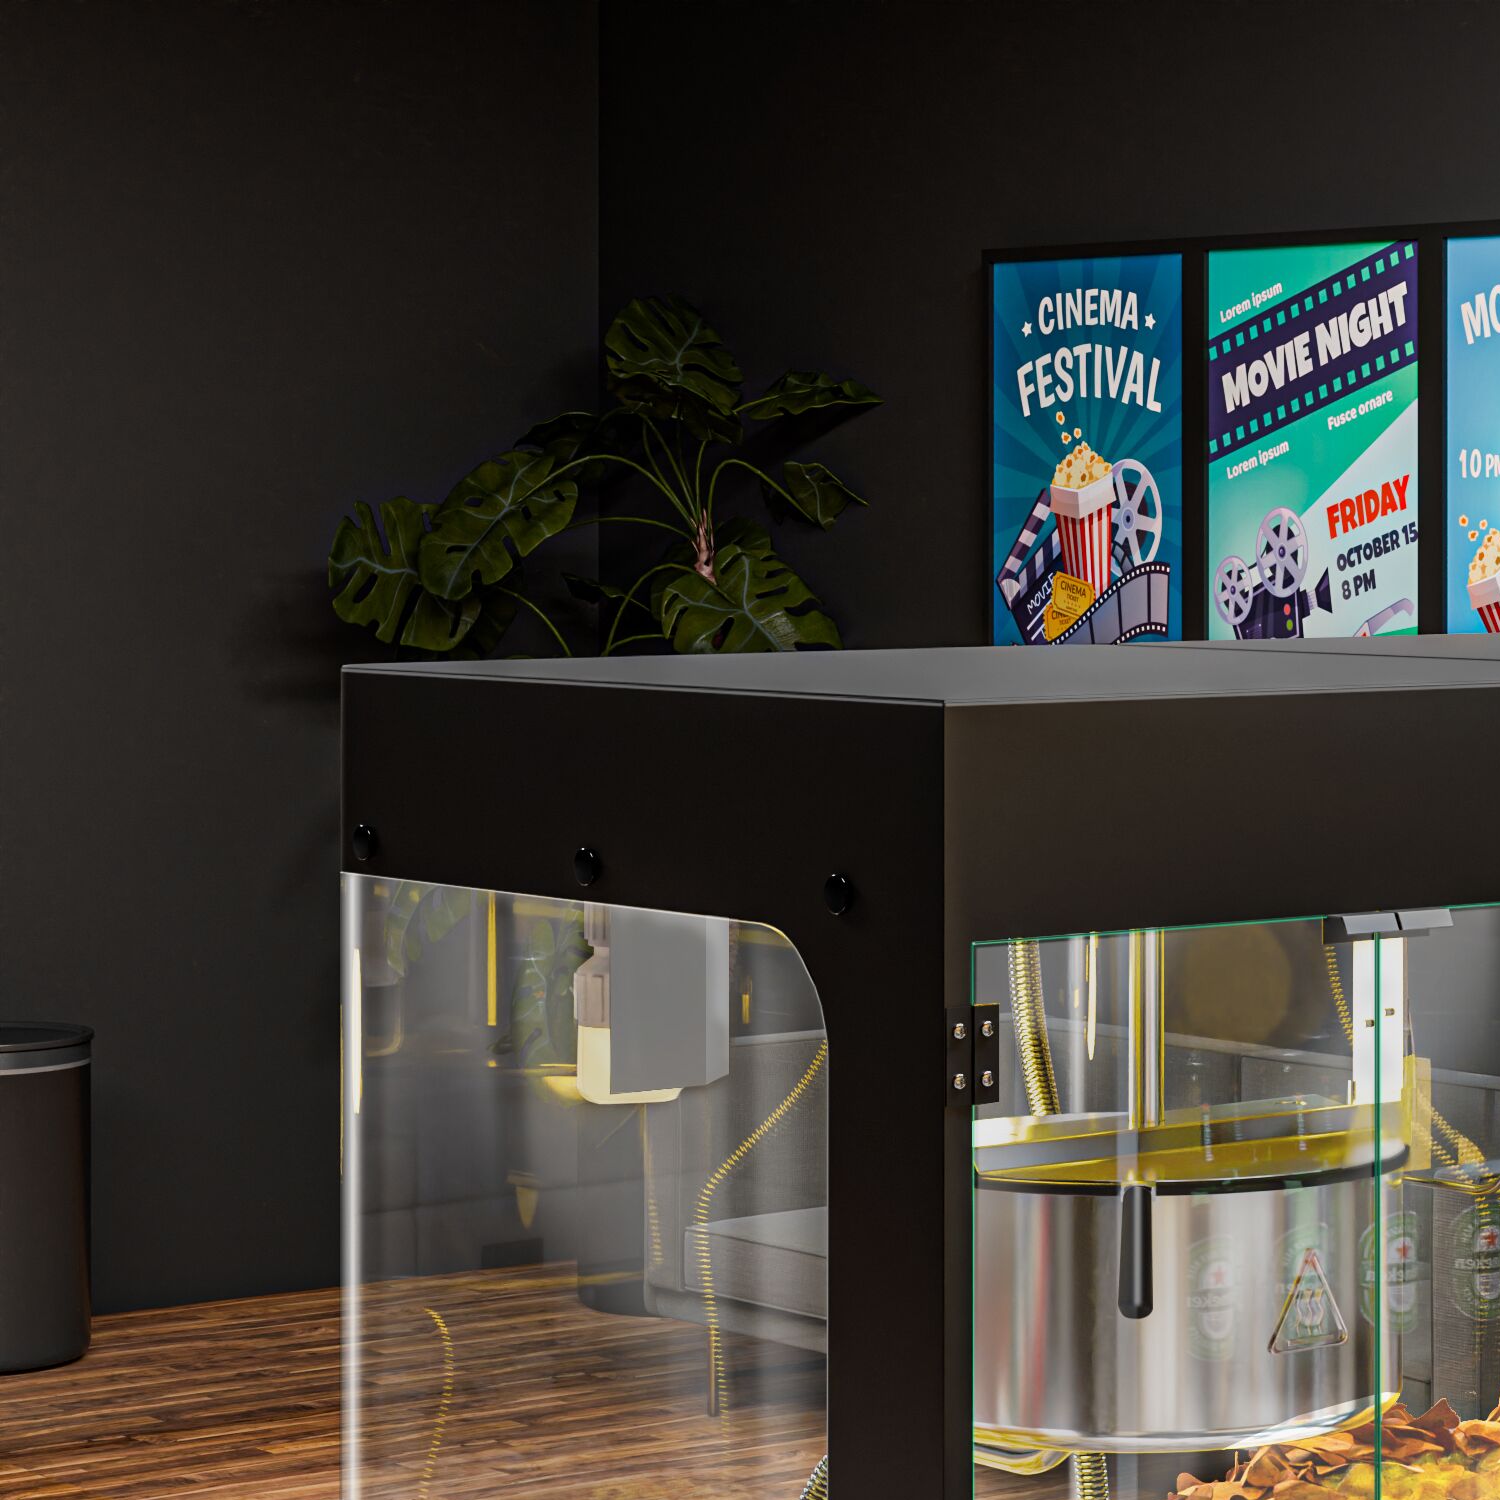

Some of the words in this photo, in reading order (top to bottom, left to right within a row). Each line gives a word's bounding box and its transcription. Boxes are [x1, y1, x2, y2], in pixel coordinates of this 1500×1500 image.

[1038, 288, 1139, 335] CINEMA
[1219, 299, 1251, 323] Lorem
[1251, 282, 1283, 308] ipsum
[1221, 331, 1314, 414] MOVIE
[1314, 280, 1408, 367] NIGHT
[1016, 343, 1162, 418] FESTIVAL
[1327, 408, 1357, 430] Fusce
[1358, 390, 1393, 415] ornare
[1226, 455, 1258, 480] Lorem
[1258, 440, 1290, 466] ipsum
[1459, 448, 1482, 479] 10
[1326, 474, 1410, 540] FRIDAY
[1336, 529, 1400, 572] OCTOBER
[1401, 521, 1418, 546] 15
[1060, 580, 1086, 598] CINEMA
[1341, 579, 1352, 601] 8
[1353, 568, 1377, 596] PM
